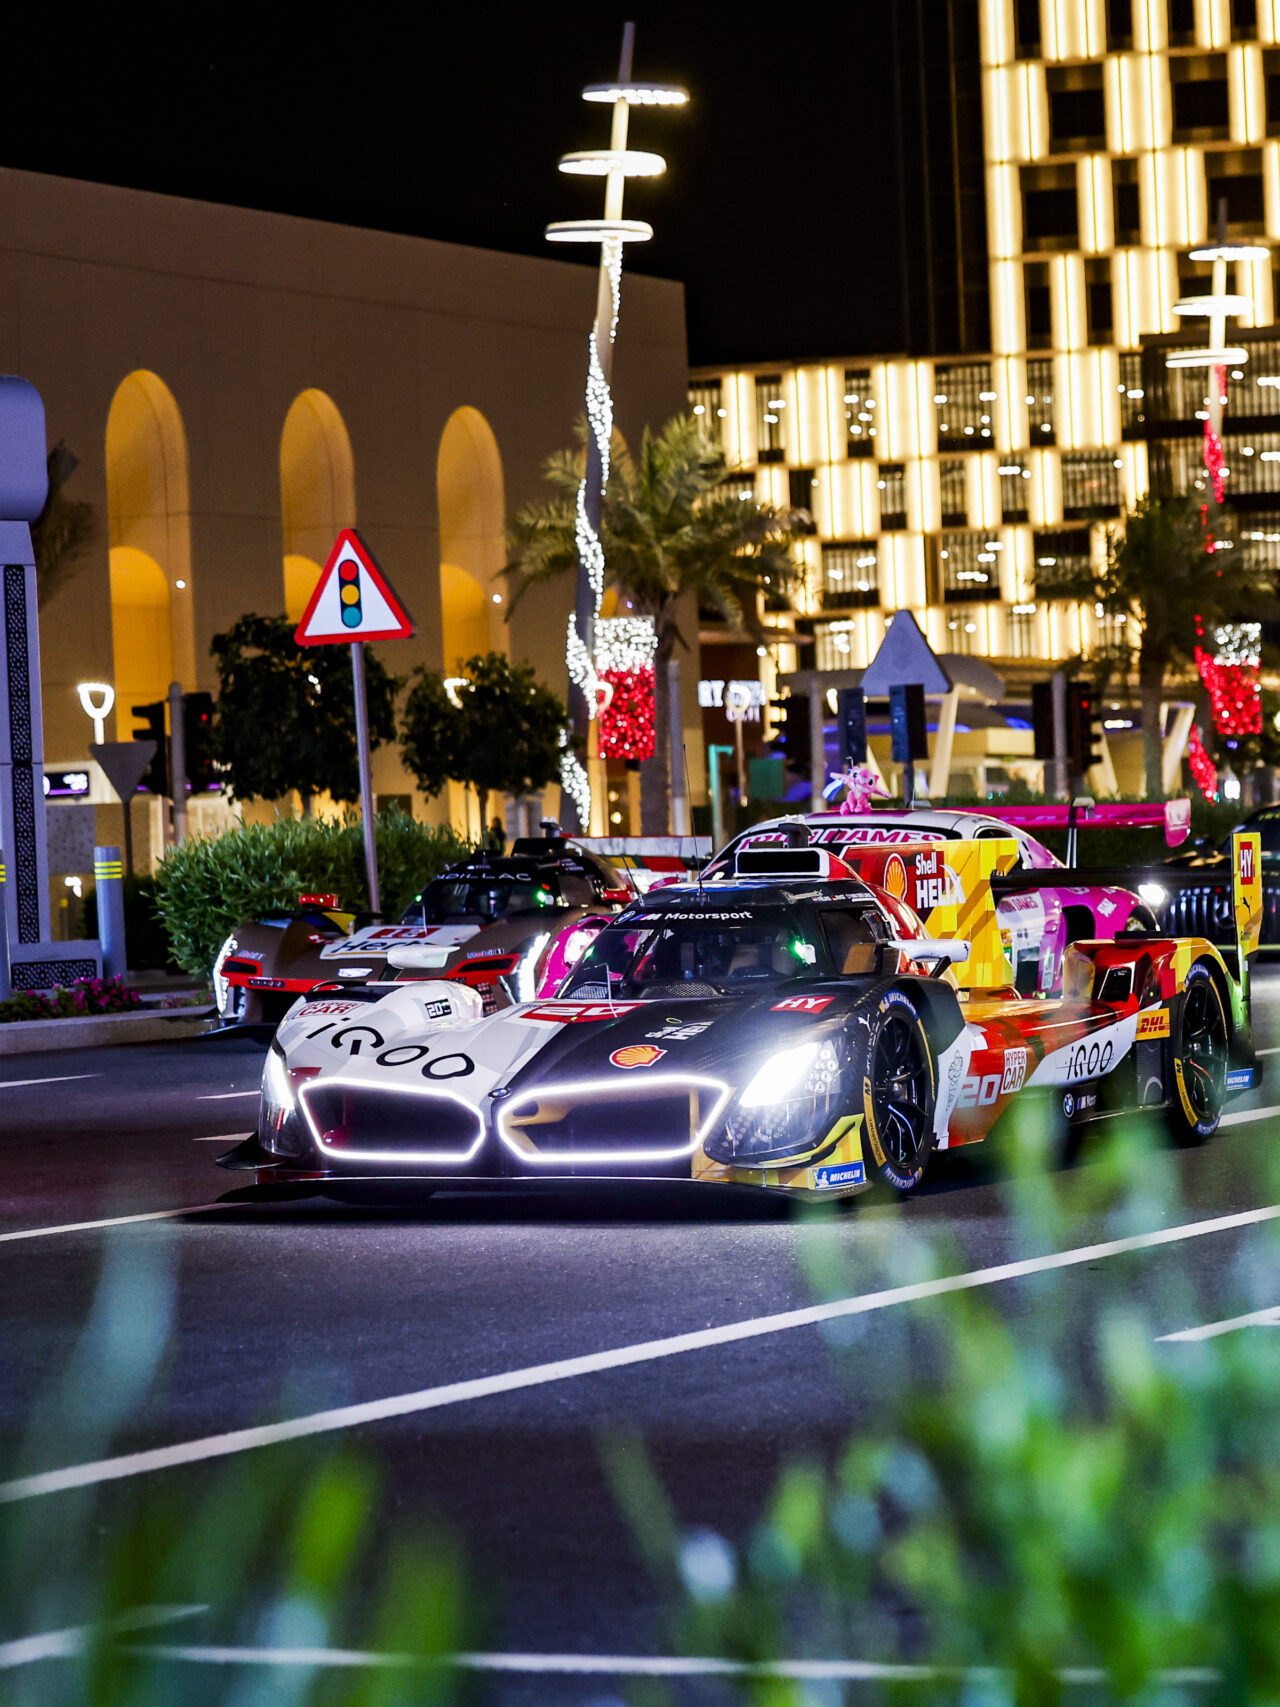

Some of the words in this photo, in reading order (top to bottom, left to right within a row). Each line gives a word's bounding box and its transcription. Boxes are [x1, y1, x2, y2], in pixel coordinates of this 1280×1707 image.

[915, 852, 938, 876] Shell
[1240, 849, 1252, 877] HY
[916, 867, 967, 909] HELIX
[664, 911, 753, 920] Motorsport
[299, 1007, 350, 1017] CAR
[778, 998, 830, 1009] HY
[1139, 1015, 1166, 1033] DHL
[1005, 1051, 1026, 1066] HYPER
[1002, 1066, 1025, 1092] CAR
[956, 1074, 1003, 1109] 20
[829, 1168, 860, 1184] MICHELIN
